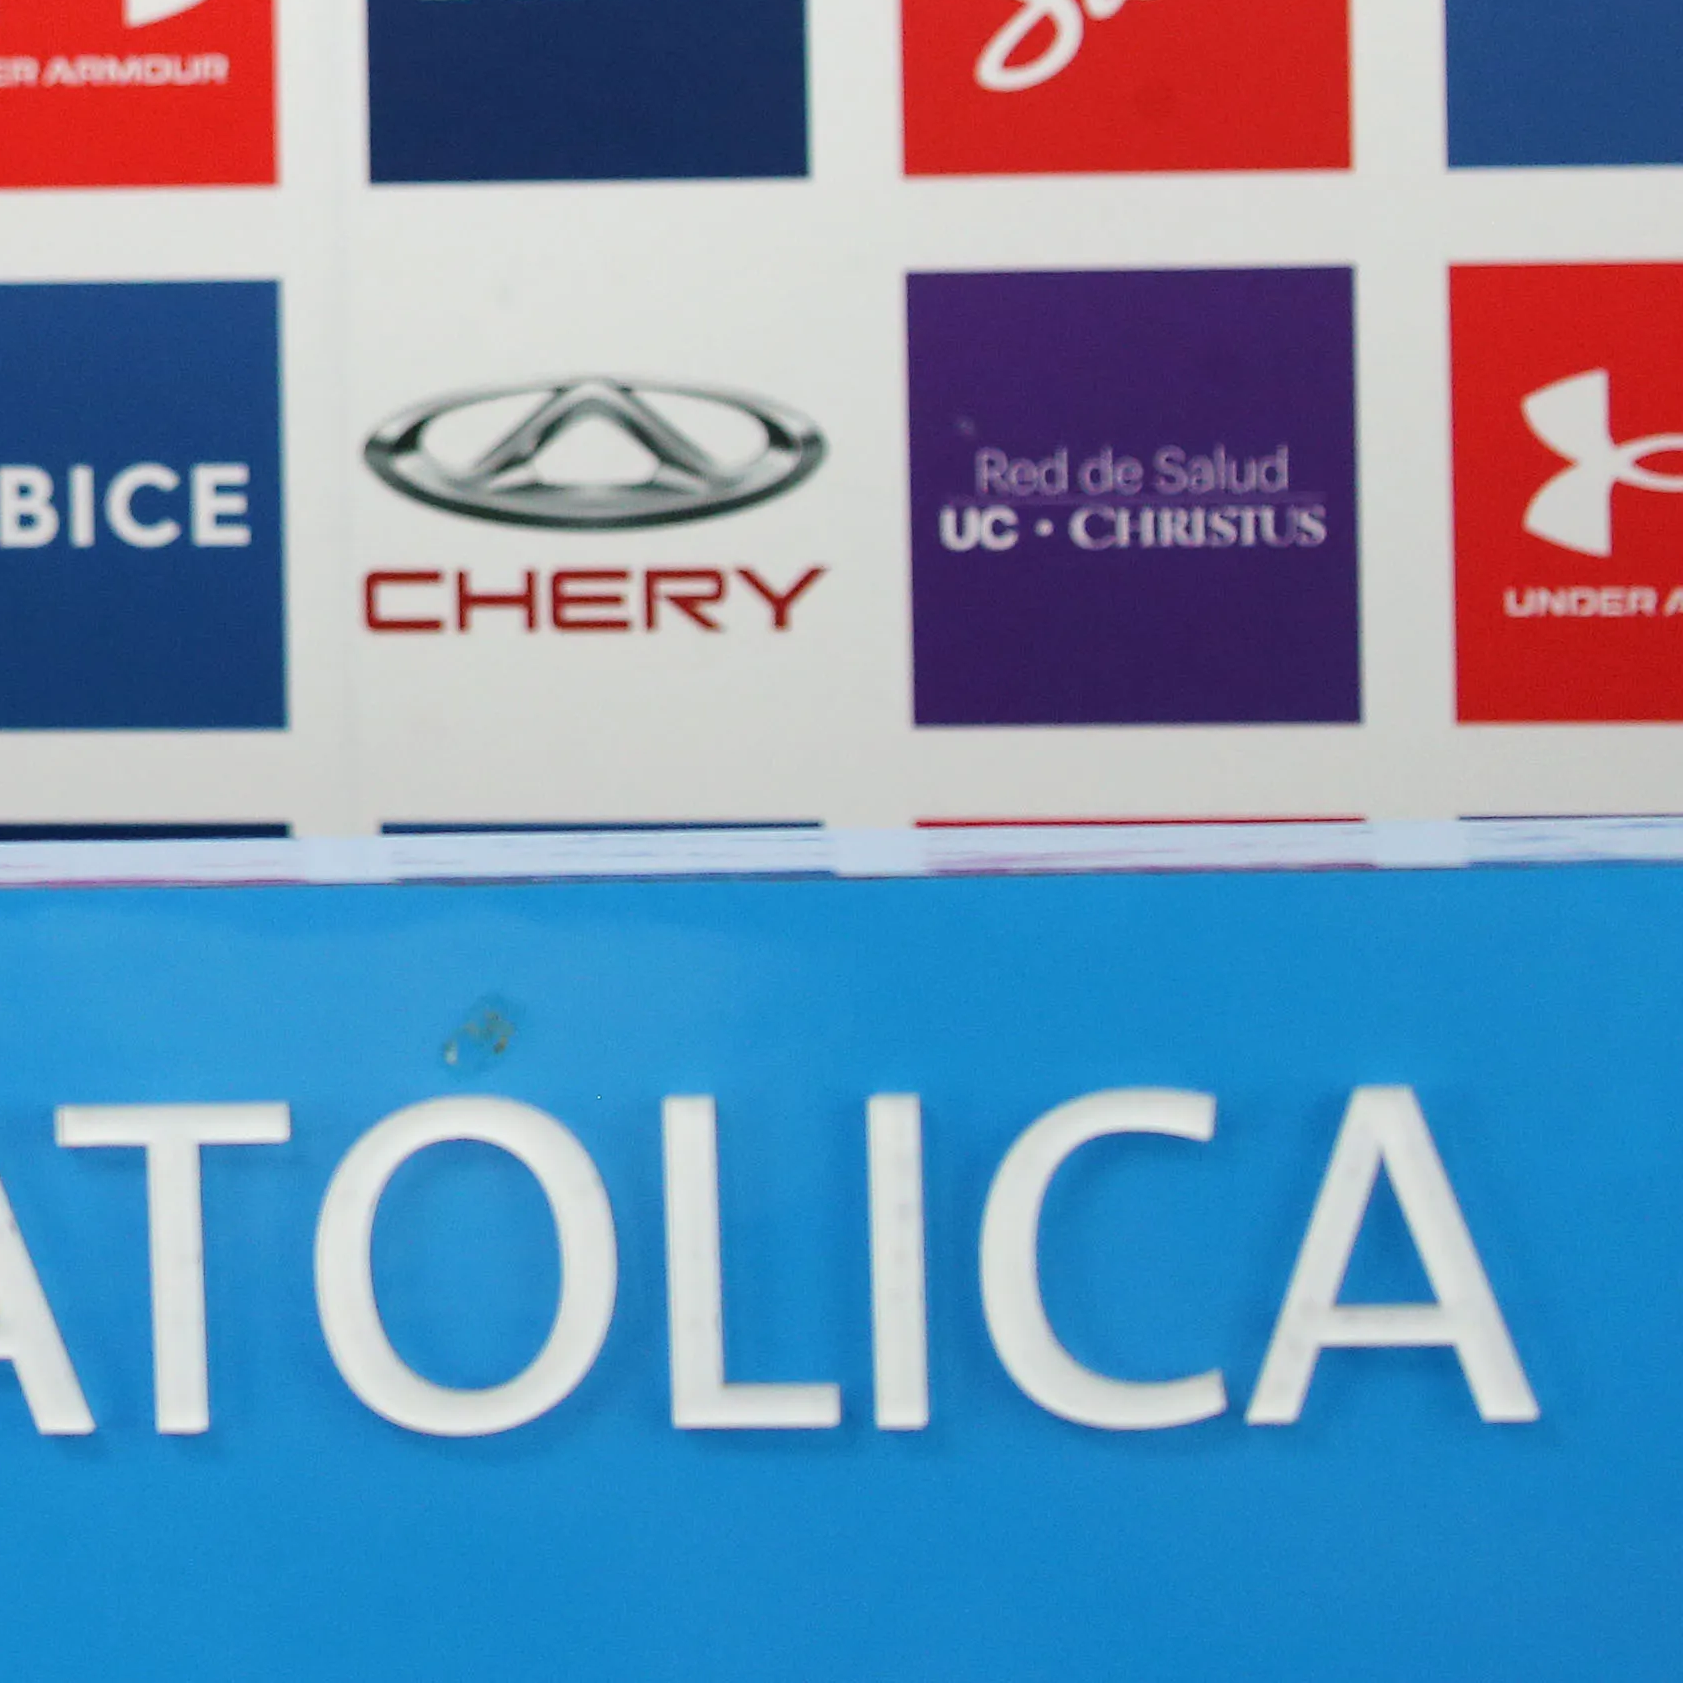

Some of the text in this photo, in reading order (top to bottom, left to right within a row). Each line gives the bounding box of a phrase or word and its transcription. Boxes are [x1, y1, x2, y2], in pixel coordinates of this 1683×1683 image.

[43, 54, 229, 85] ARMOUR
[975, 443, 1289, 494] Red de Salud
[940, 505, 1326, 551] UC CHRISTUS
[364, 568, 823, 633] CHERY
[1505, 587, 1658, 617] UNDER
